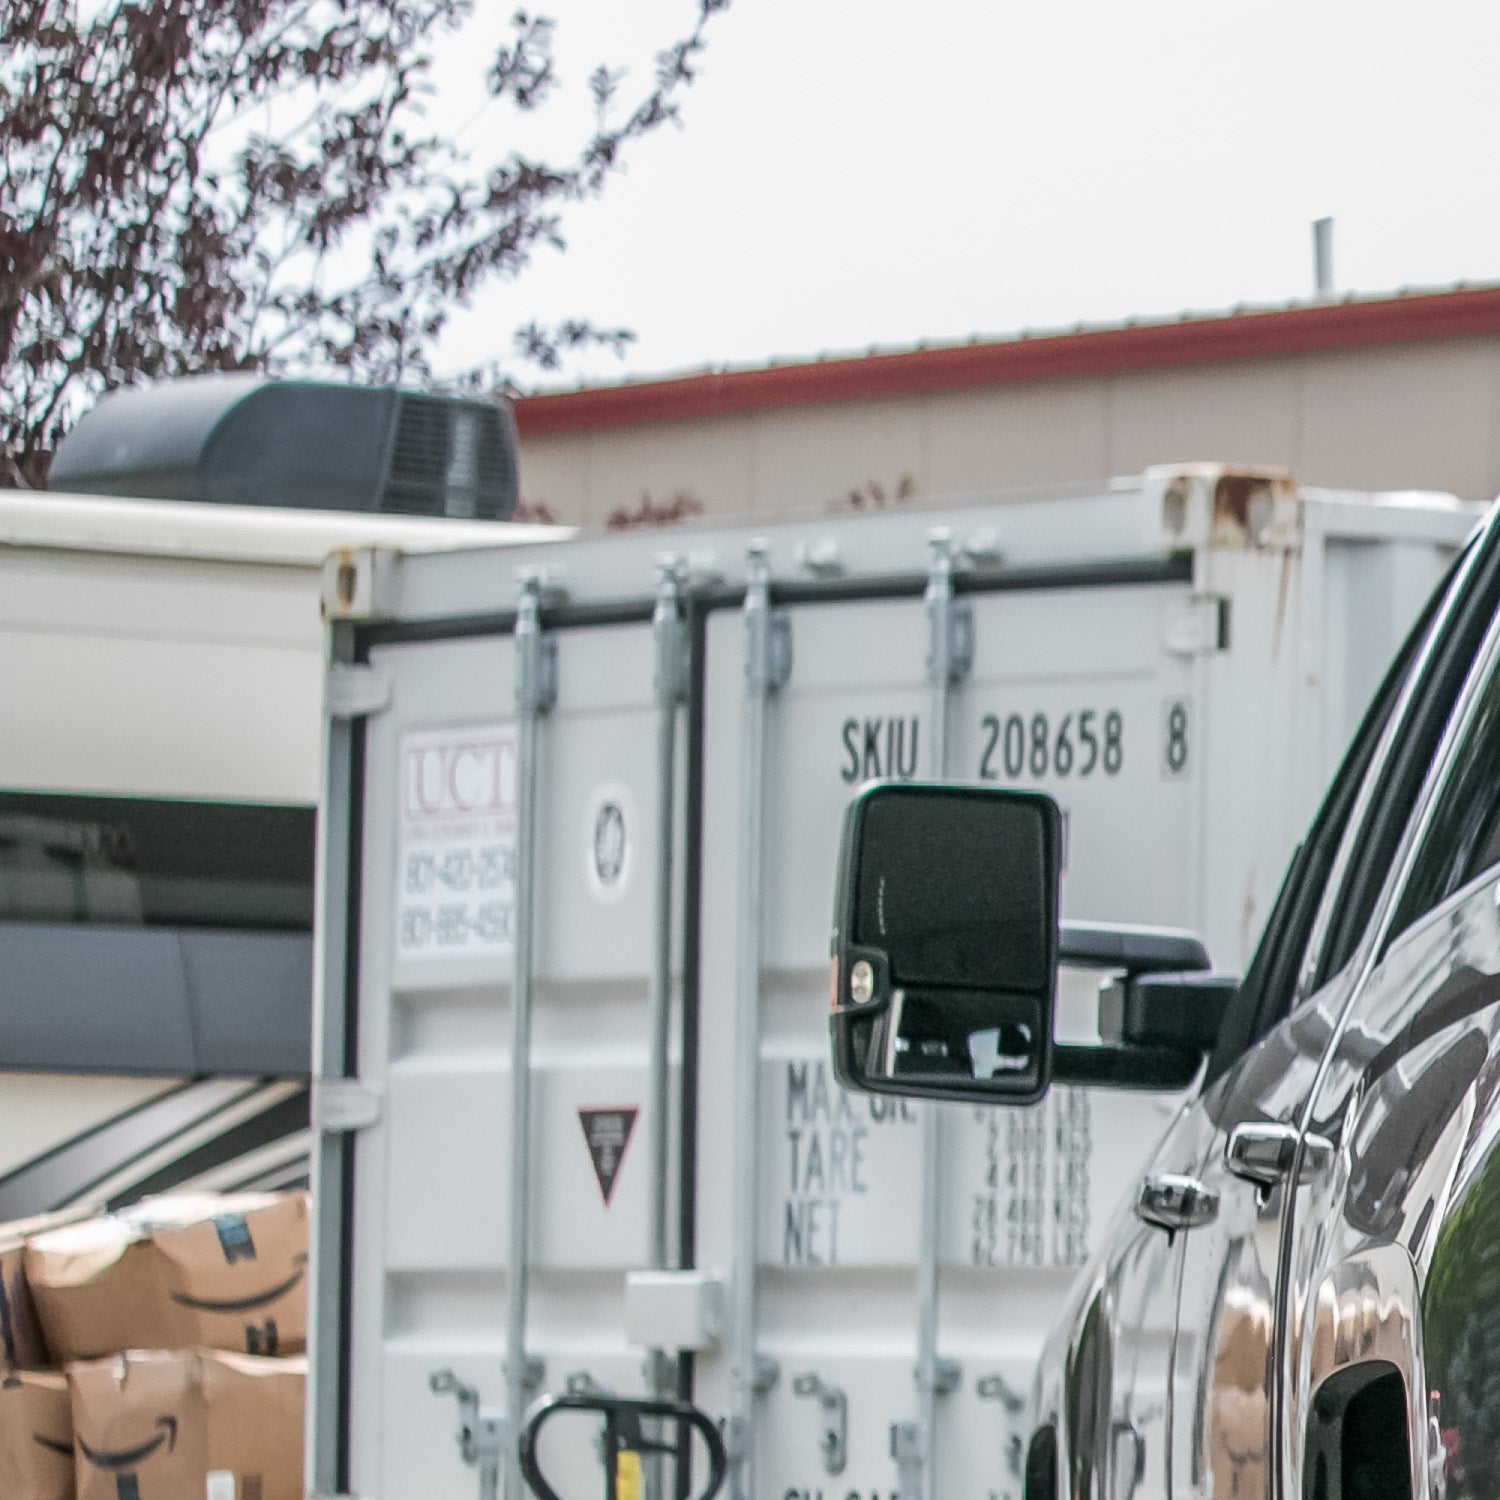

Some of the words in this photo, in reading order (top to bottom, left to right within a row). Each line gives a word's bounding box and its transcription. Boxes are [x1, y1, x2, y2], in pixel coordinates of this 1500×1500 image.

[841, 715, 918, 784] SKIU
[979, 707, 1123, 780] 208658
[1167, 701, 1187, 773] 8
[787, 1128, 868, 1194] TARE
[785, 1199, 840, 1267] NET
